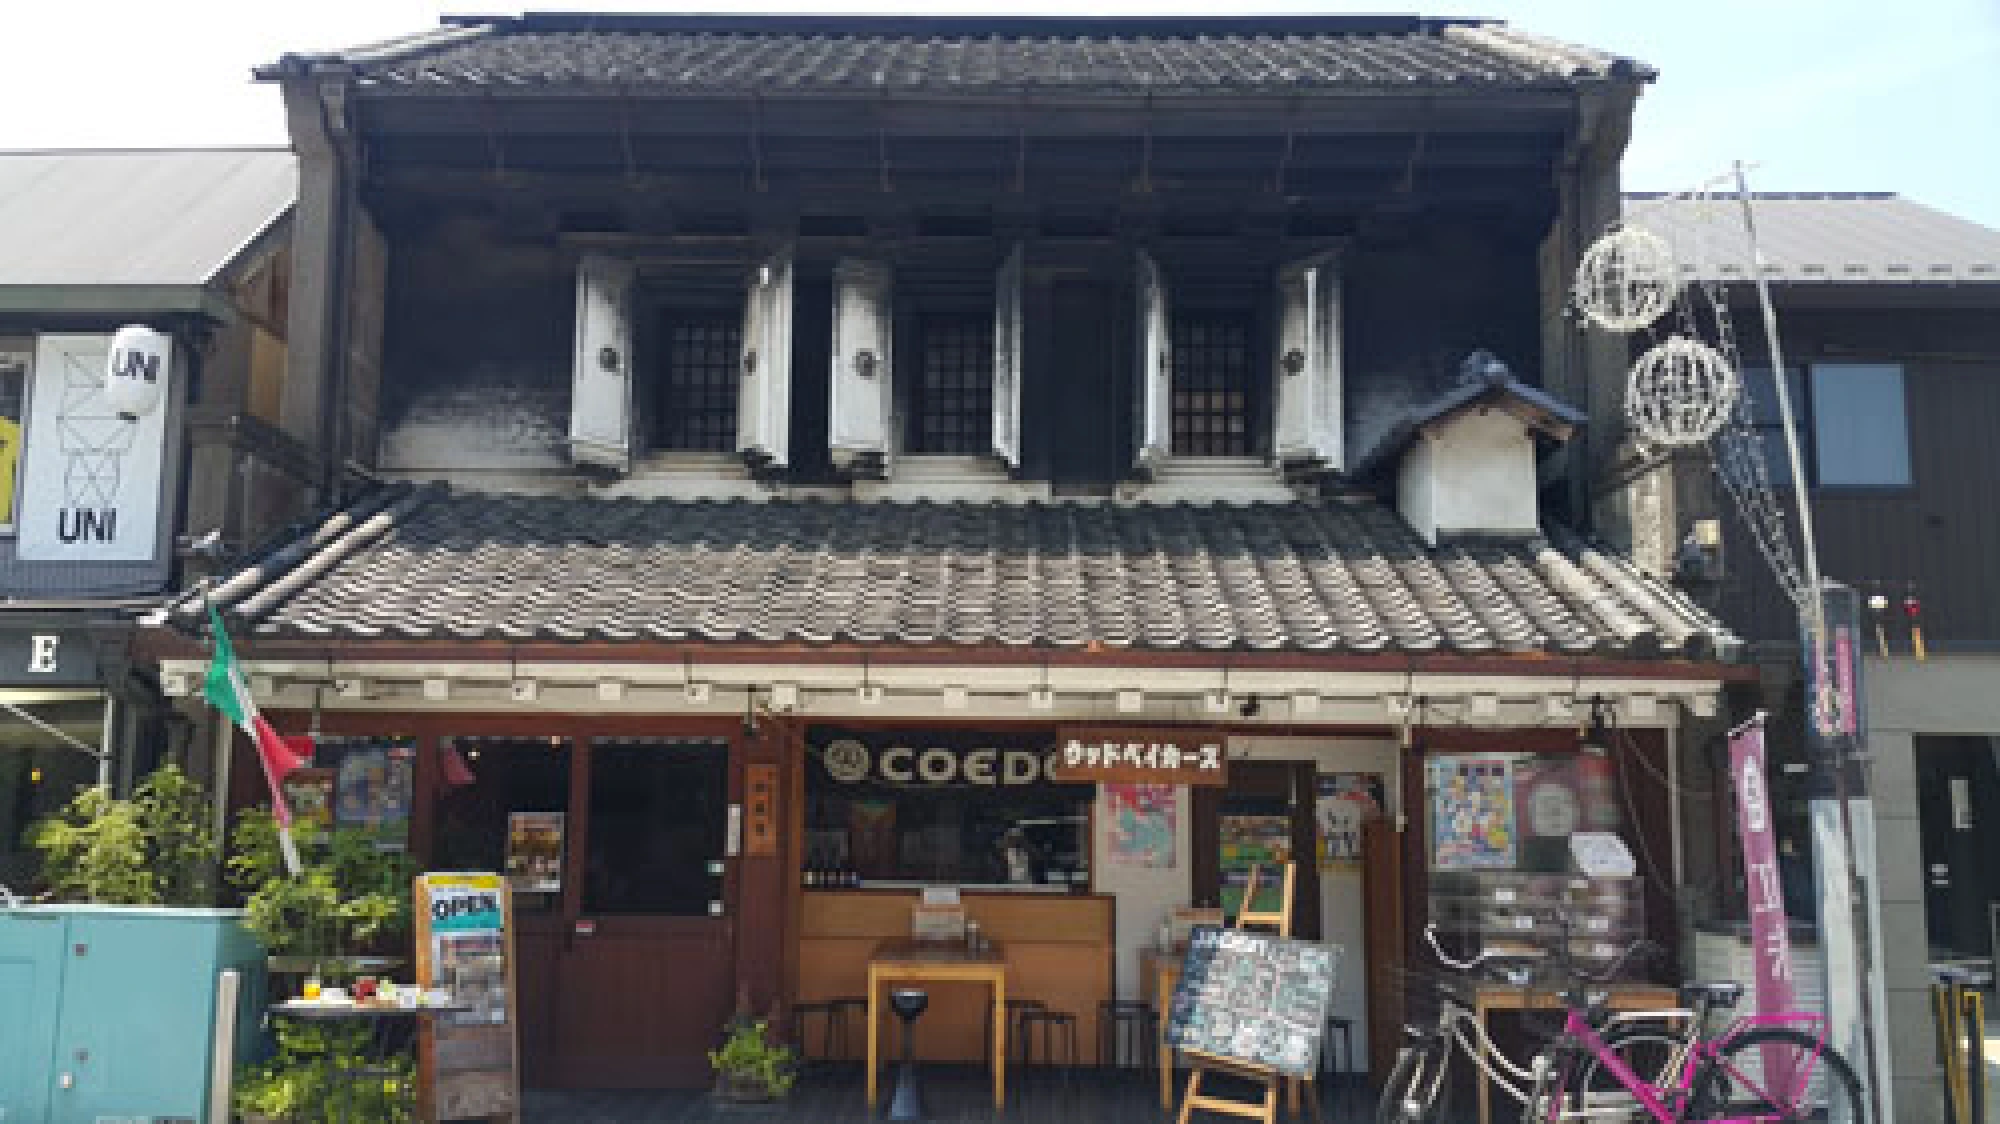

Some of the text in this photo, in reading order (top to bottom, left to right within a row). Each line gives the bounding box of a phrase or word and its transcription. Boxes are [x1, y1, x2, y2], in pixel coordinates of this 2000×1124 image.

[59, 508, 117, 544] UNI
[28, 636, 60, 672] E
[432, 894, 497, 920] OPEN
